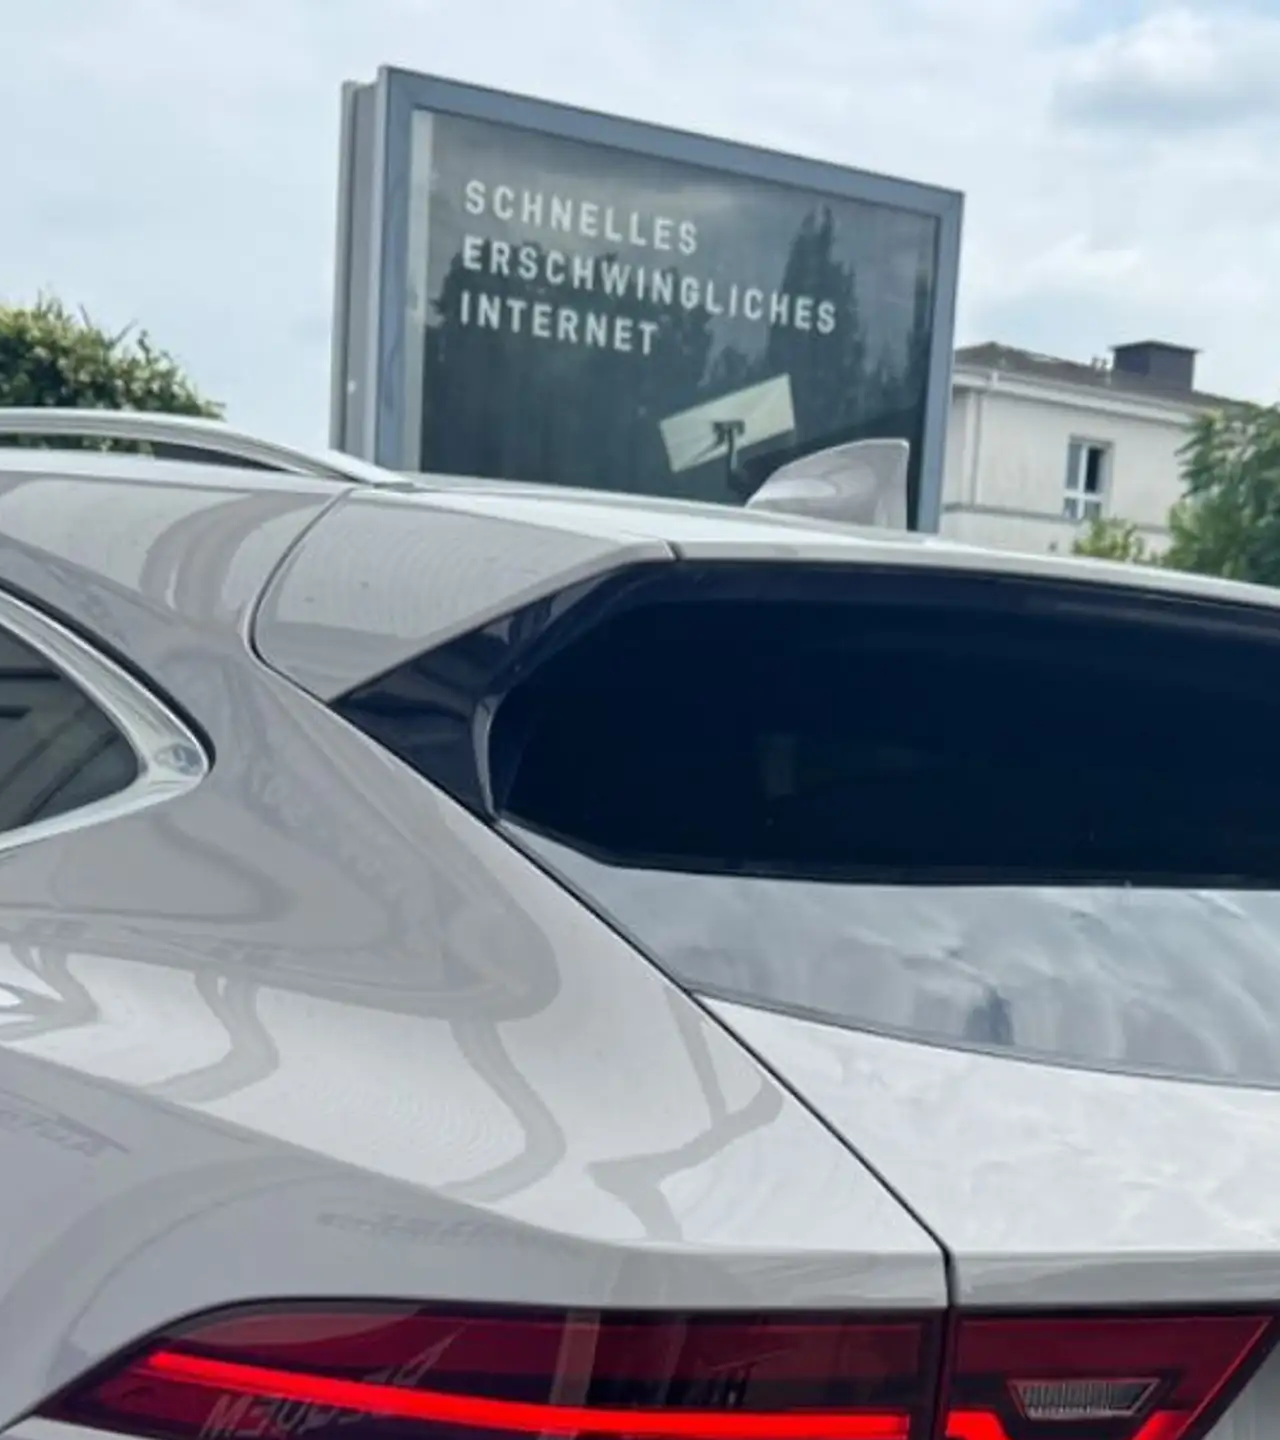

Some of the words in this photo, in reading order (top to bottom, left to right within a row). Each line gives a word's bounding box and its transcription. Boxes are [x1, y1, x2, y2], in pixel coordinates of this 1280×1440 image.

[464, 179, 699, 256] SCHNELLES
[459, 290, 660, 356] INTERNET
[461, 234, 838, 335] ERSCHWINGLICHES
